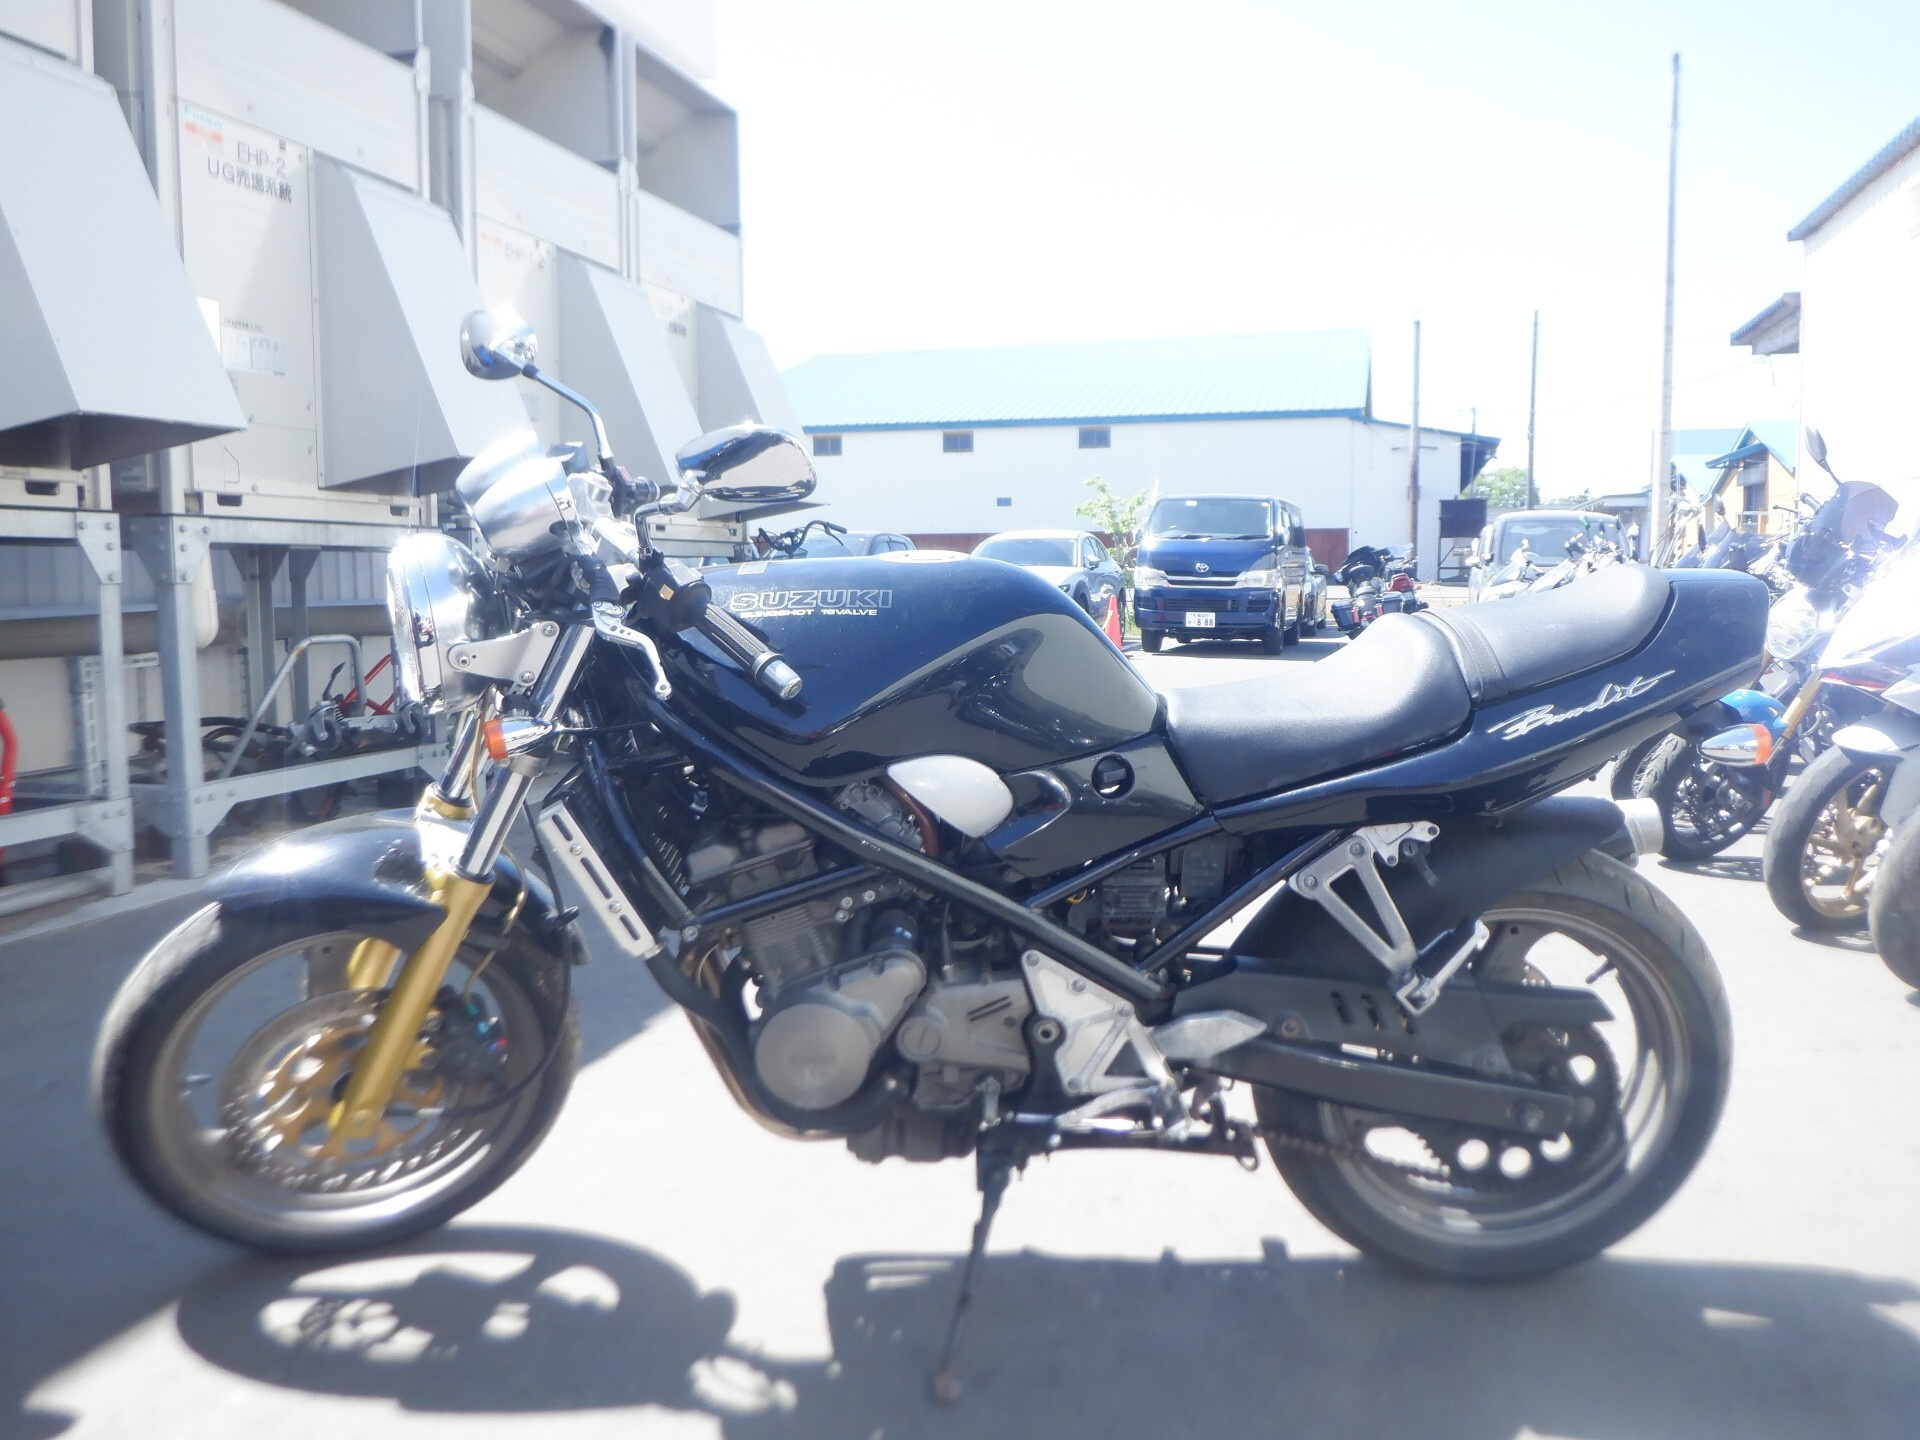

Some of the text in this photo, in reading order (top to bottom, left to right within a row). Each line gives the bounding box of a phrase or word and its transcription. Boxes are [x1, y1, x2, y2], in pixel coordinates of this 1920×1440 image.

[237, 141, 287, 177] EHP-2
[729, 589, 893, 611] SUZUKI
[1486, 669, 1676, 741] Bandit
